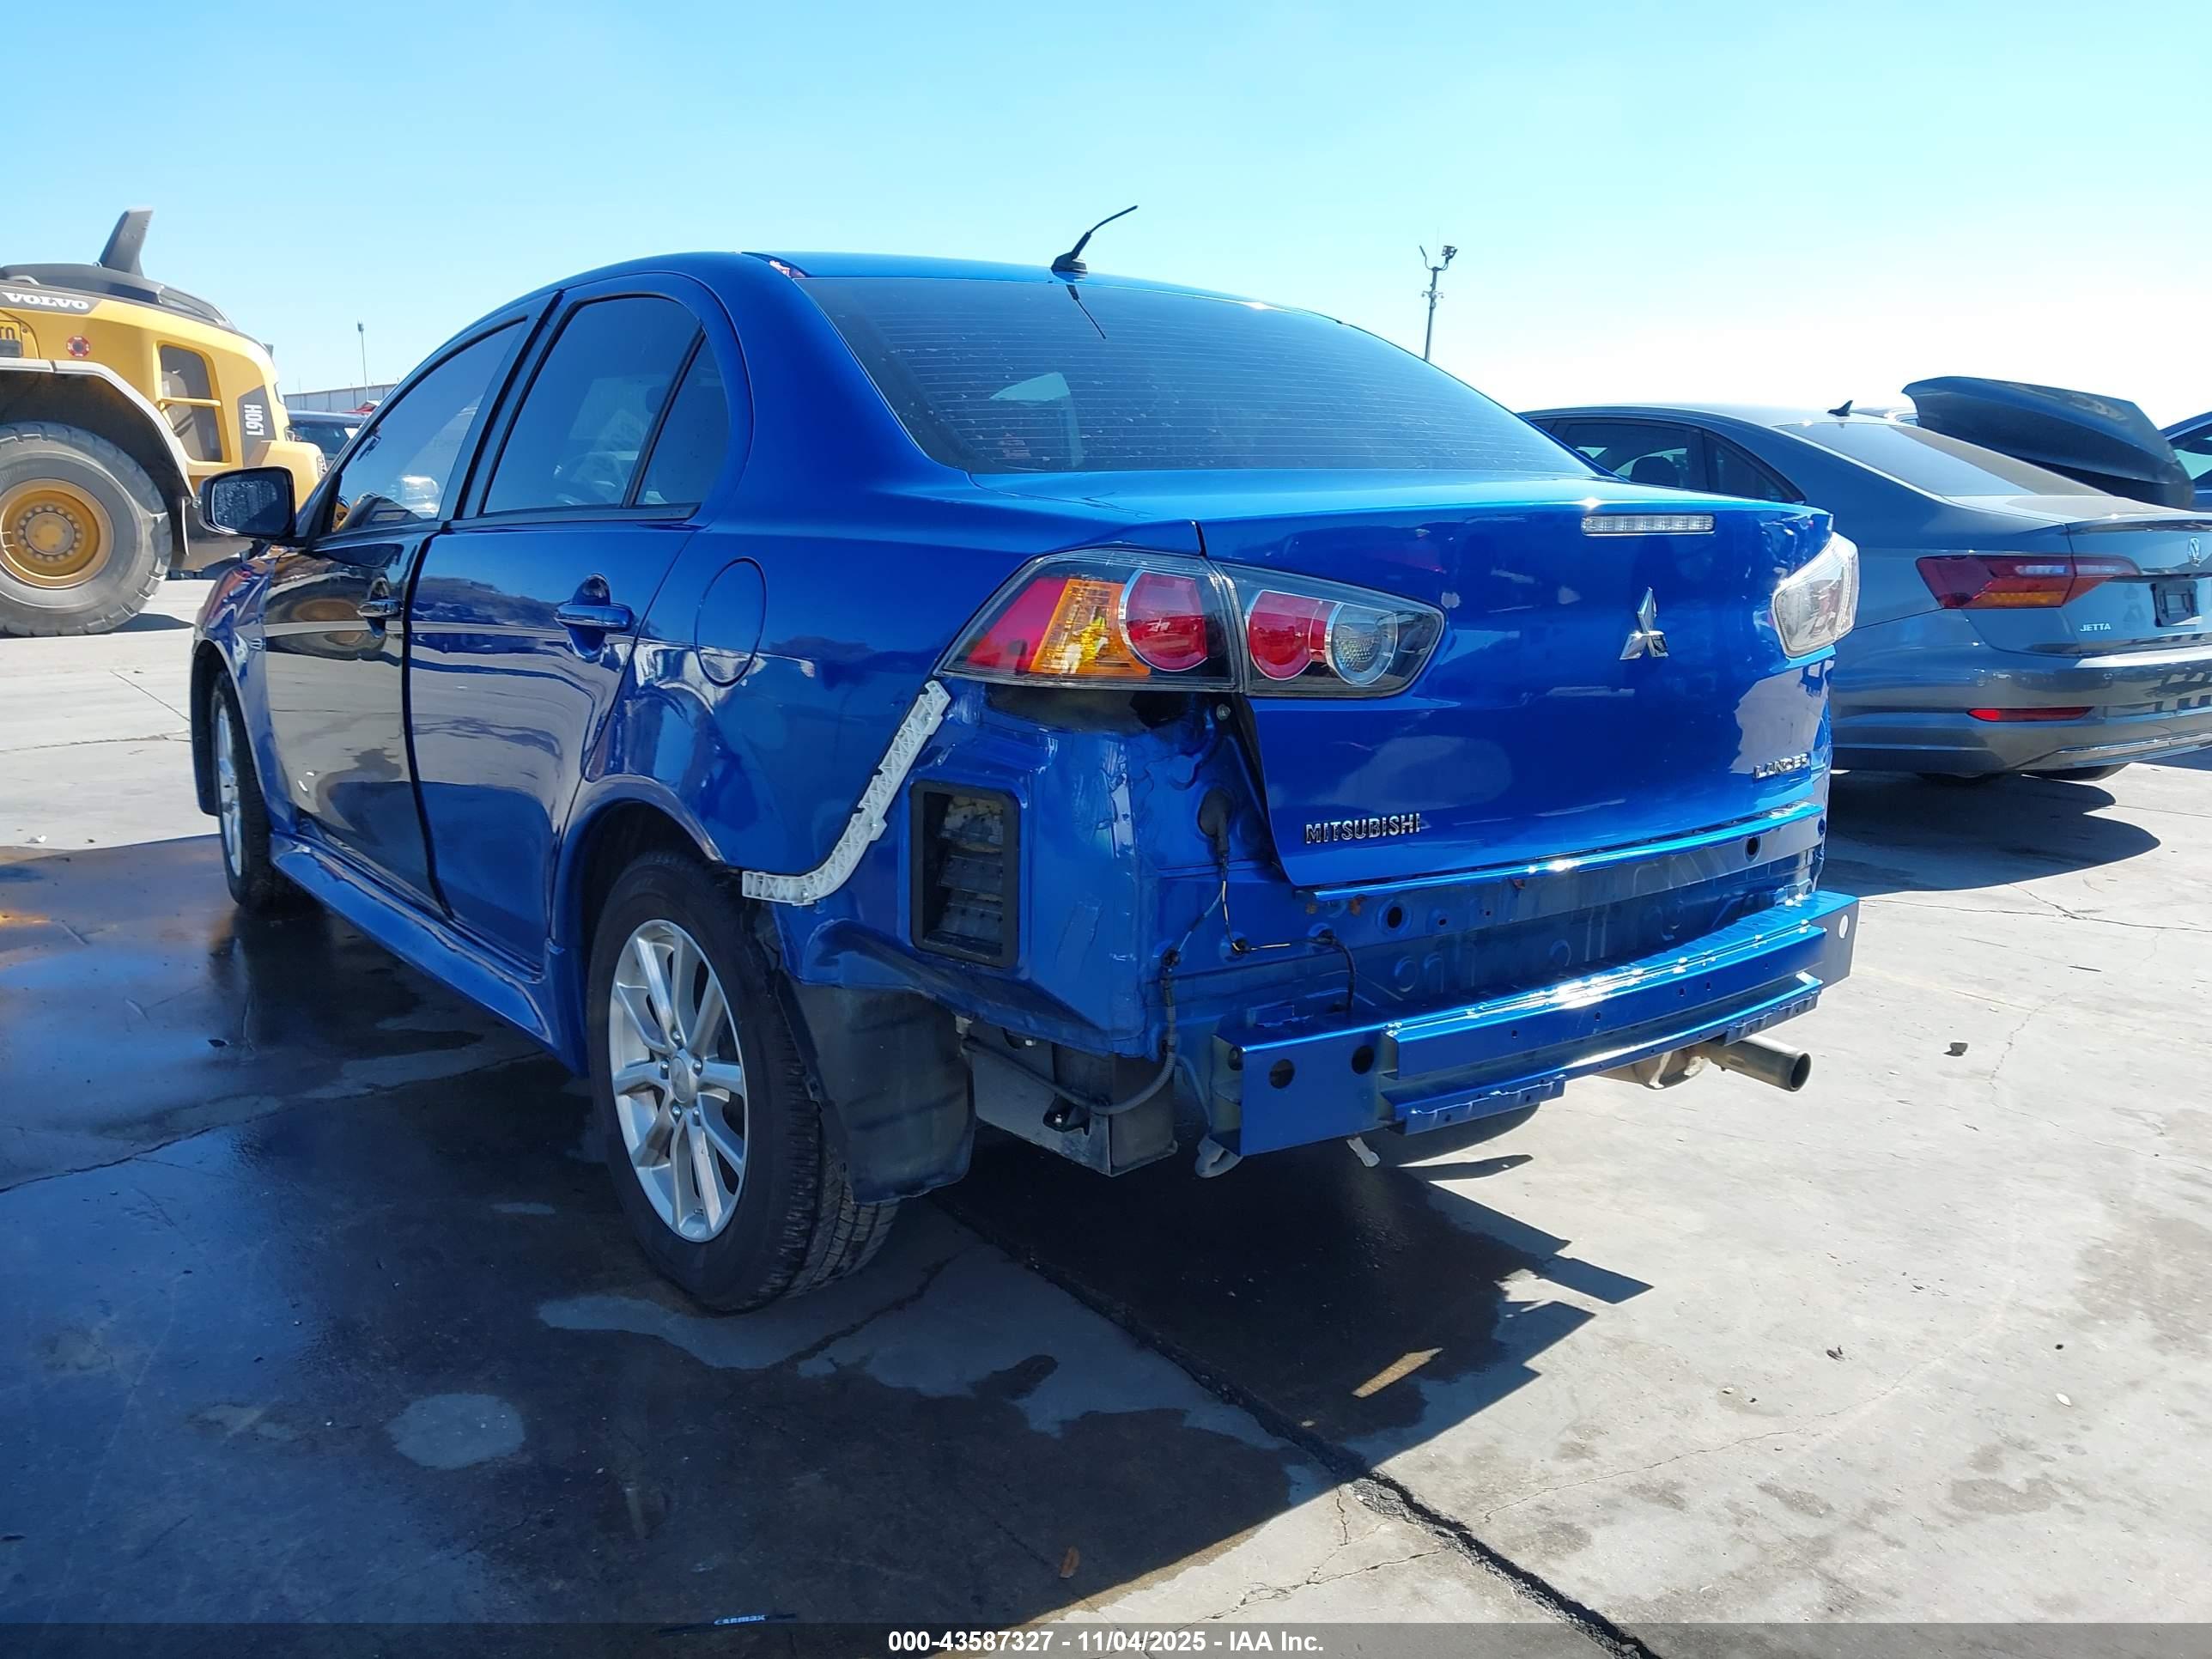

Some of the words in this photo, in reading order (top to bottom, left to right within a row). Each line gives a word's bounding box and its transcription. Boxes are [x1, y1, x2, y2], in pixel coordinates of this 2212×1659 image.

[2, 292, 89, 310] VOLVO
[244, 404, 264, 436] L90H
[2079, 623, 2112, 632] JETTA
[1305, 812, 1420, 844] MITSUBISHI
